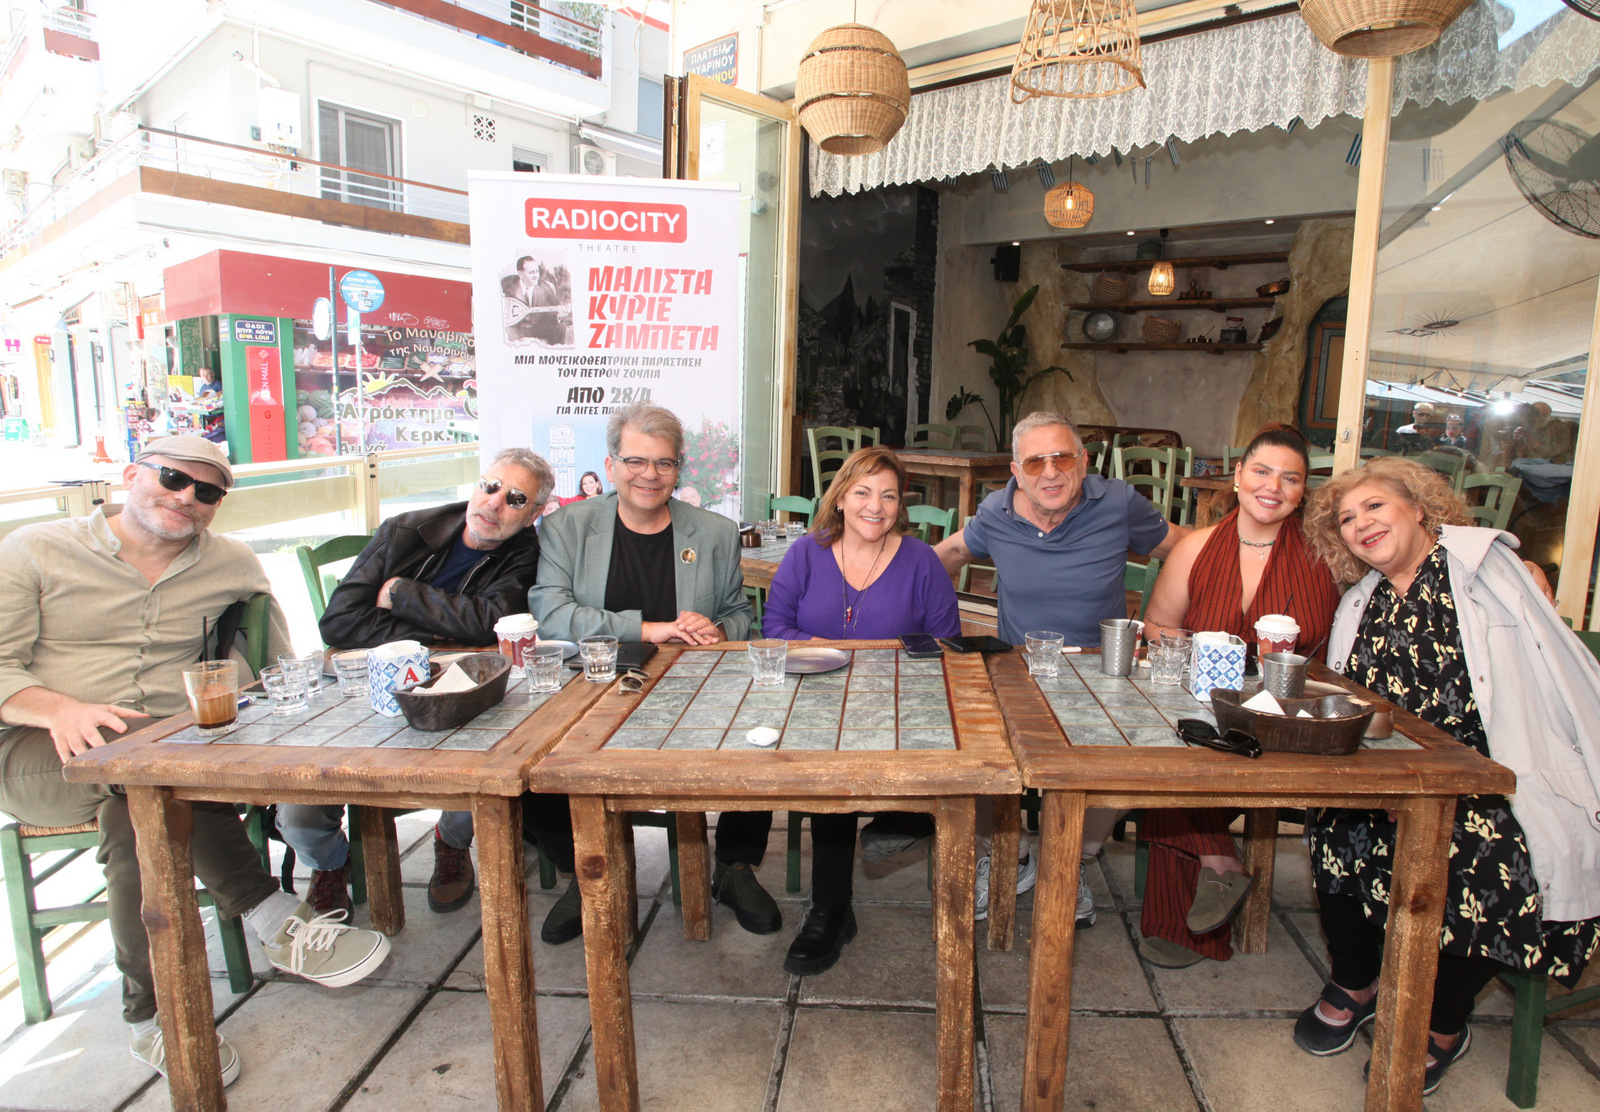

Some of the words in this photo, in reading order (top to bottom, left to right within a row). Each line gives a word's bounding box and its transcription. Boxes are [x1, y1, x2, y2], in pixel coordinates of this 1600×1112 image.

[691, 43, 728, 65] ΠΛΑΤΕΙΑ
[532, 207, 680, 234] RADIOCITY
[578, 243, 638, 254] THEATRE
[588, 265, 713, 295] ΜΑΛΙΣΤΑ
[588, 294, 673, 322] ΚΥΡΙΕ
[245, 322, 266, 330] ΟΔΟΣ
[384, 329, 402, 342] Το
[588, 323, 719, 351] ΖΑΜΠΕΤΑ
[389, 346, 411, 357] της
[514, 355, 535, 365] ΜΙΑ
[538, 355, 639, 366] ΜΟΥΣΙΚΟΘΕΑΤΡΙΚΗ
[642, 356, 702, 368] ΠΑΡΑΣΤΑΣΗ
[261, 362, 269, 380] MALL
[557, 368, 577, 378] ΤΟΥ
[580, 368, 620, 378] ΠΕΤΡΟΥ
[623, 369, 661, 379] ΖΟΥΛΙΑ
[567, 386, 605, 404] ΑΠΟ
[610, 386, 652, 404] 28/4
[556, 406, 571, 415] ΓΙΑ
[573, 406, 599, 415] ΛΙΓΕΣ
[403, 666, 420, 686] A
